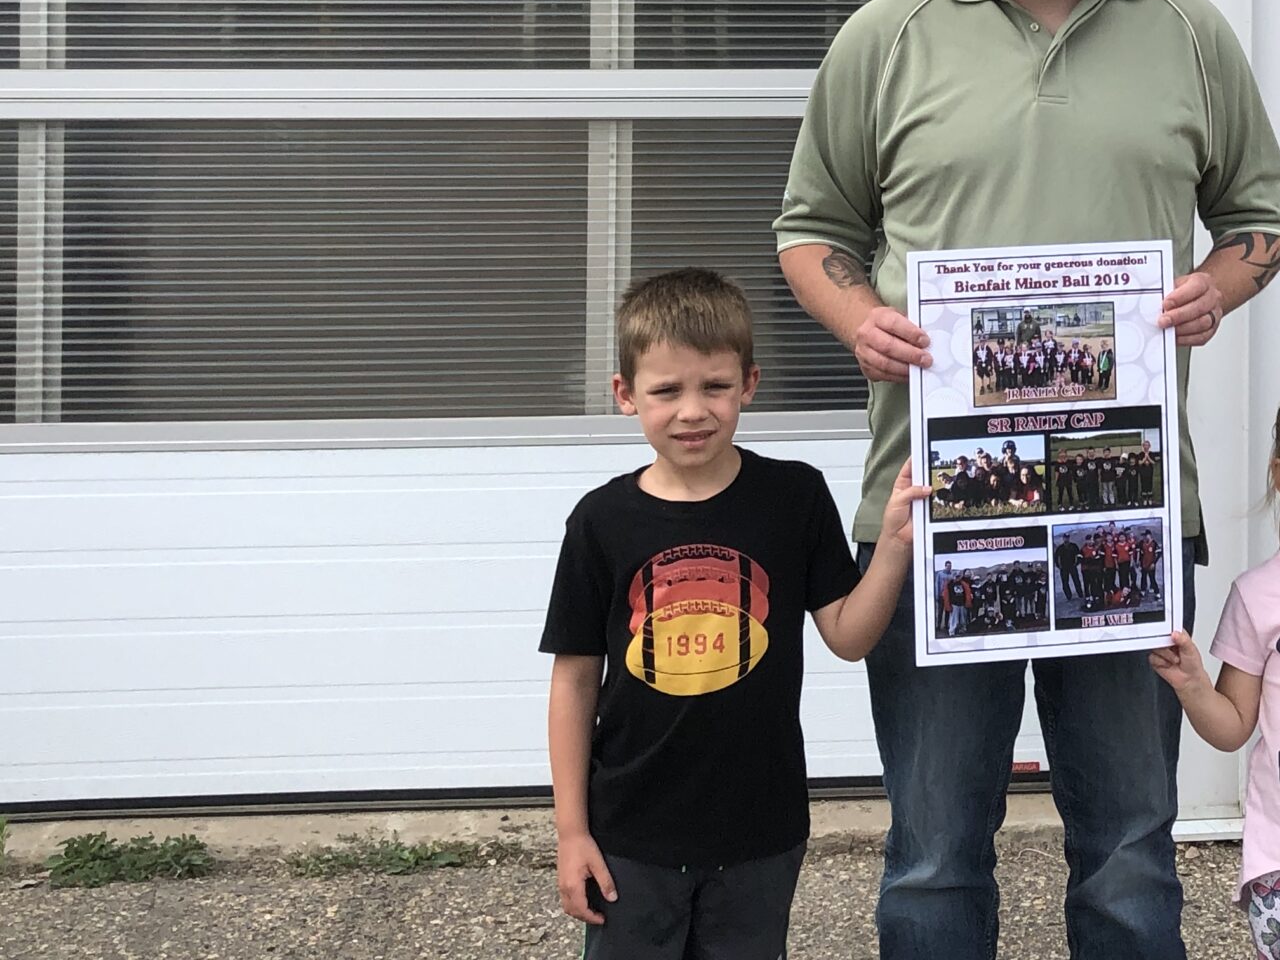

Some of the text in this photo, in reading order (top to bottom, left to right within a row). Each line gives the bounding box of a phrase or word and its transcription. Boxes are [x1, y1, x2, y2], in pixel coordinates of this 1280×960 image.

[935, 255, 1147, 274] Thank You for your generous donation!
[954, 272, 1131, 293] Bienfait Minor Ball 2019
[1005, 383, 1086, 402] JR RALLY CAP
[988, 412, 1105, 433] SR RALLY CAP
[957, 536, 1025, 551] MOSQUITO
[1081, 612, 1134, 628] PEE WEE
[666, 632, 726, 657] 1994
